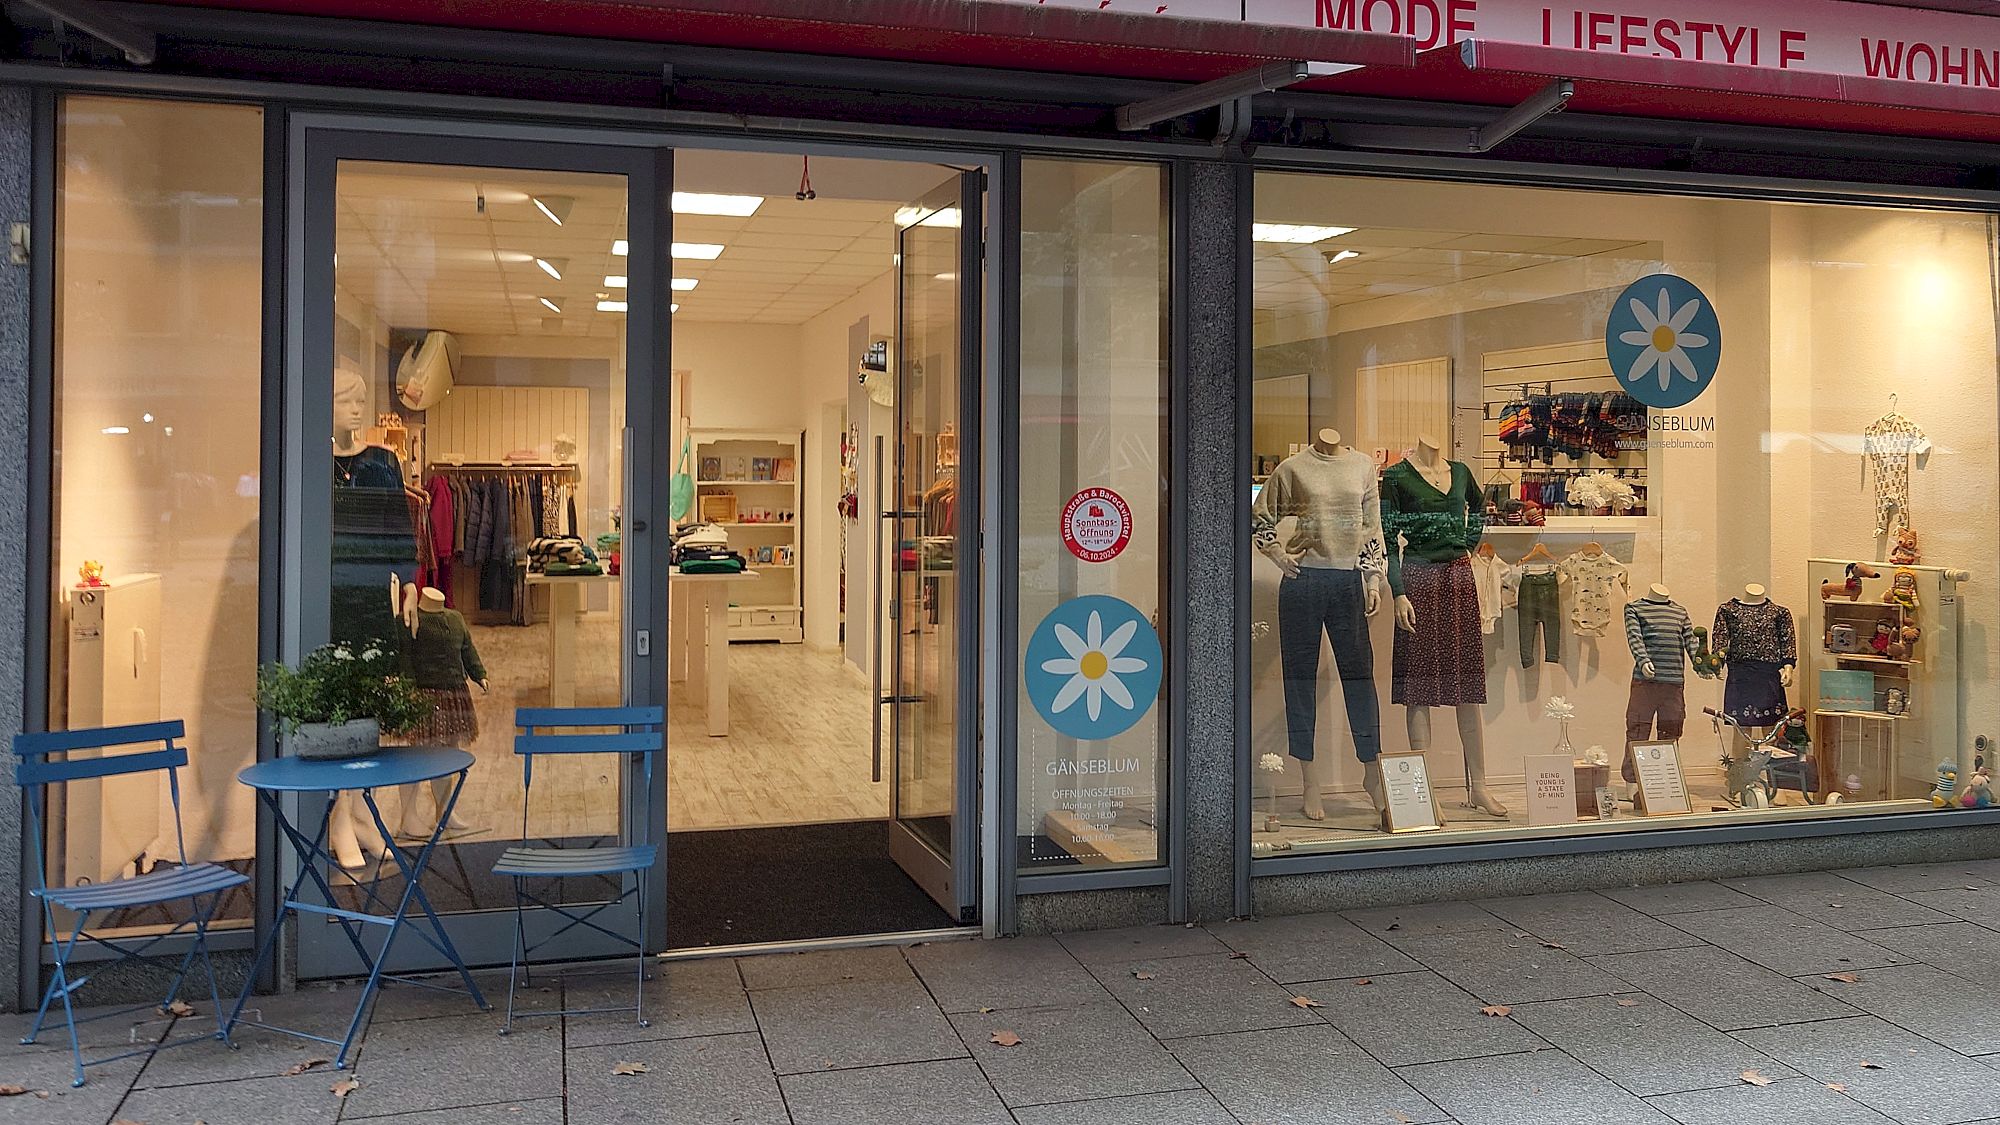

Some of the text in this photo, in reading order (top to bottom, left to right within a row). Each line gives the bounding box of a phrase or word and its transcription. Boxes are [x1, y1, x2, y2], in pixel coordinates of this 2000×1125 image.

[1315, 0, 1477, 51] MODE
[1860, 37, 2000, 88] WOHN
[1616, 411, 1715, 432] GÄNSEBLUM
[1614, 438, 1714, 450] www.gaenseblum.com
[1064, 489, 1130, 541] Hauptstraße & Barockviertel
[1076, 518, 1118, 528] Sonntags-
[1080, 526, 1114, 537] Öffnung
[1045, 757, 1140, 776] GÄNSEBLUM
[1062, 801, 1092, 811] Montag
[1097, 799, 1124, 810] Freitag
[1096, 810, 1117, 819] 18.00
